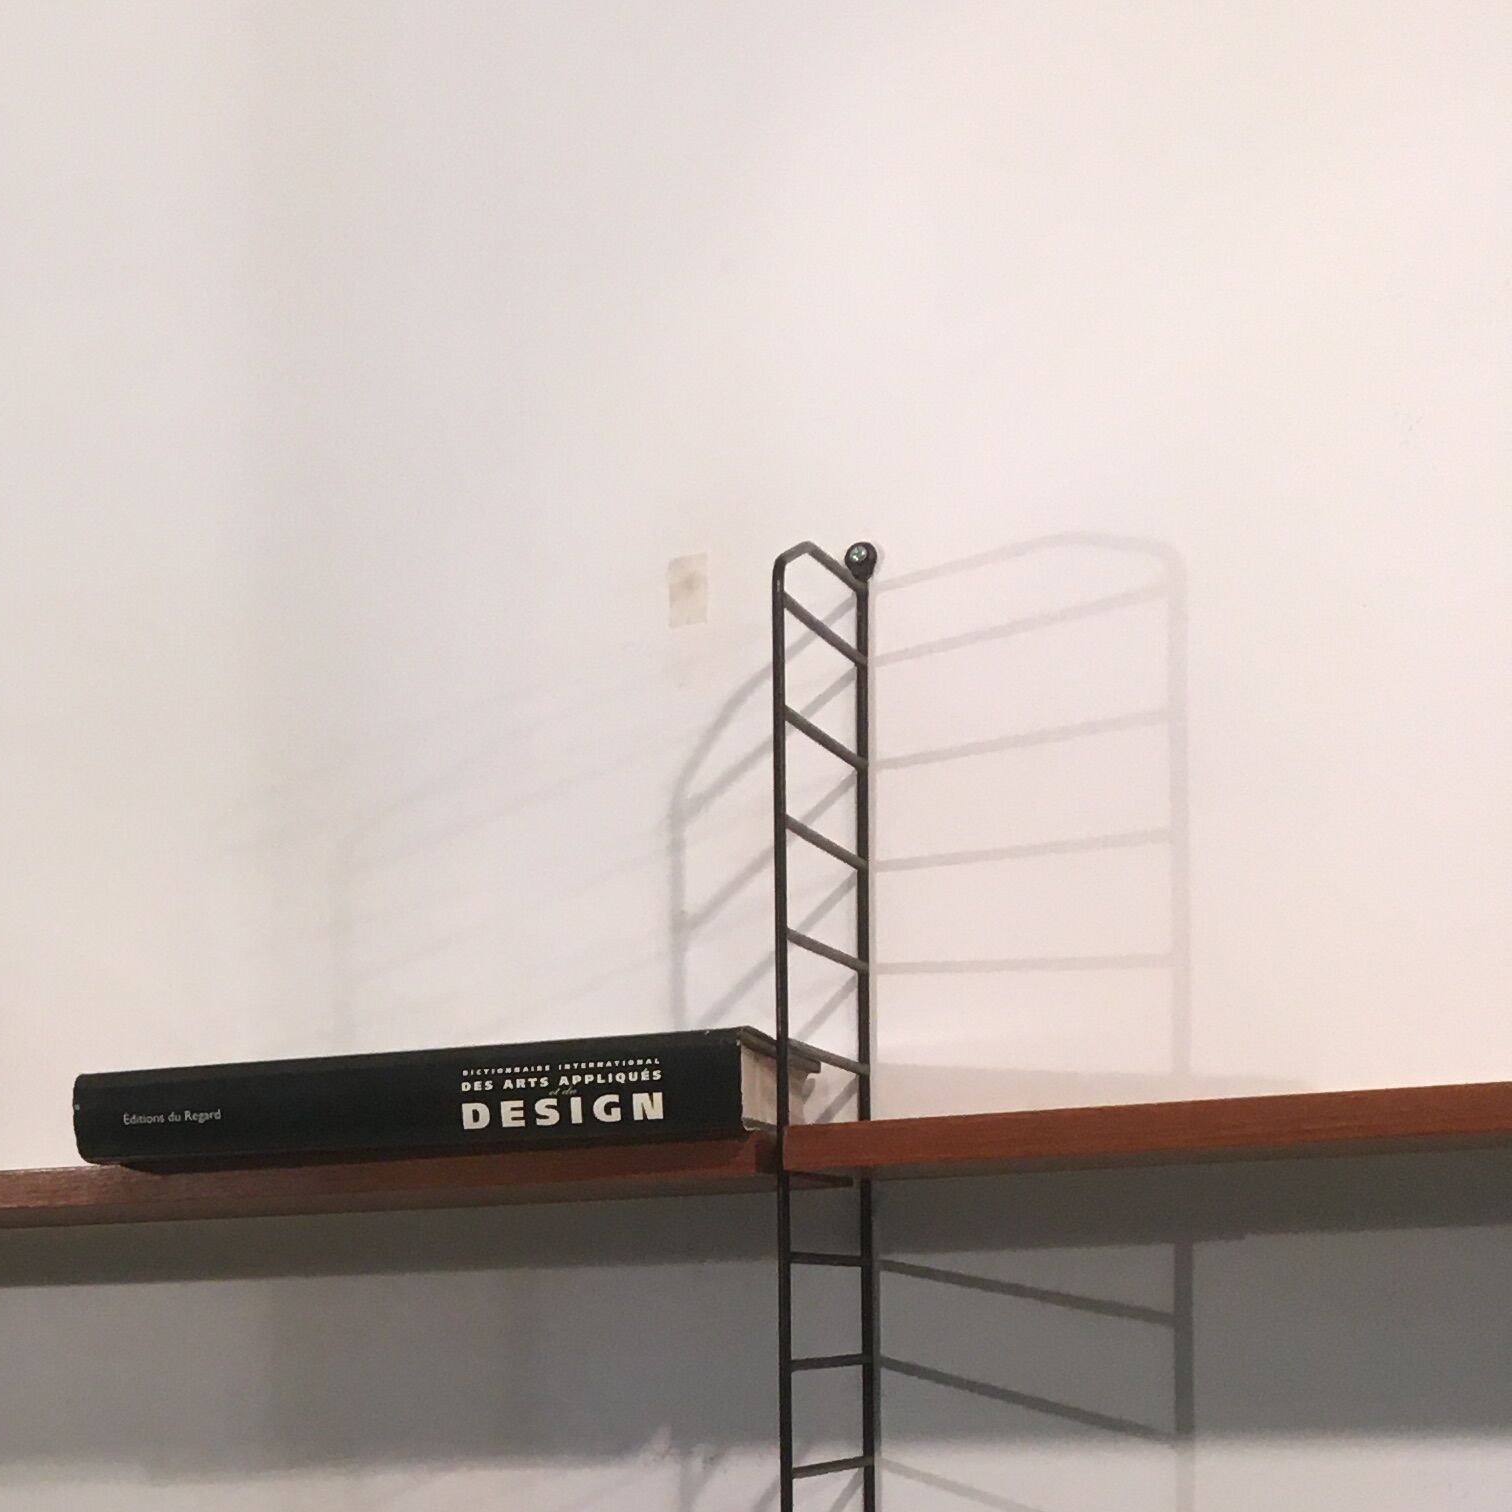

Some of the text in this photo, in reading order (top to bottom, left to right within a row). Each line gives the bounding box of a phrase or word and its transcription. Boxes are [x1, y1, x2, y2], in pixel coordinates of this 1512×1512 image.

[462, 1058, 661, 1077] DICTIONNAIRE INTERNATIONAL
[461, 1067, 662, 1092] DES ARTS APPLIQUÉS
[168, 1111, 181, 1122] du
[184, 1108, 222, 1124] Regard
[461, 1091, 664, 1130] DESIGN
